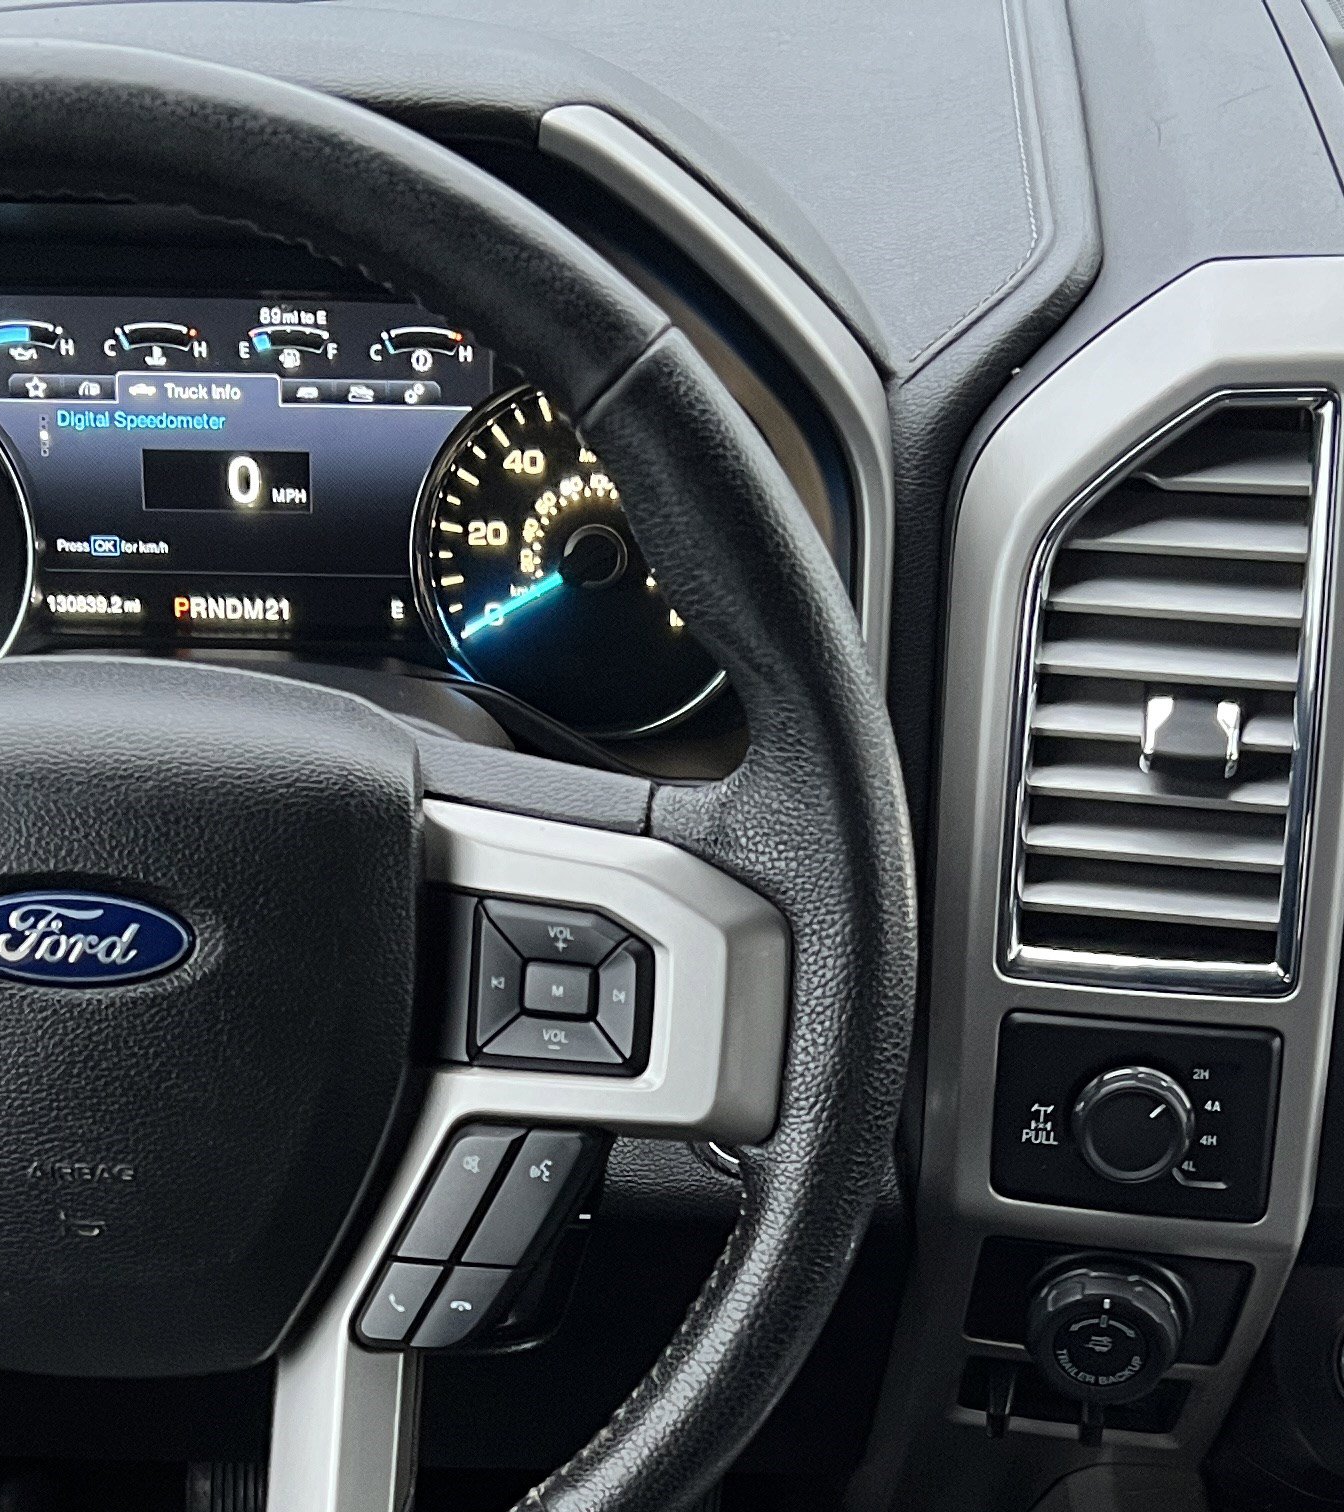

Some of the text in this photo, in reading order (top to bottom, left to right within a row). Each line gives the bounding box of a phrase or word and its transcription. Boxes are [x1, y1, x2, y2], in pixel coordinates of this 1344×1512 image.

[259, 307, 282, 325] 89
[299, 311, 315, 325] to
[316, 310, 327, 325] E
[59, 338, 75, 355] H
[103, 339, 207, 358] C H
[238, 341, 338, 359] E F
[370, 344, 473, 362] C H
[164, 382, 241, 401] Truck Info
[56, 410, 226, 431] Digital Speedometer
[503, 449, 545, 475] 40
[227, 455, 307, 504] 0 MPH
[468, 520, 508, 546] 20
[56, 538, 169, 554] Press OK for km/h
[391, 599, 404, 620] E
[547, 926, 575, 941] VOL
[551, 986, 564, 997] M
[542, 1029, 569, 1044] VOL
[1192, 1069, 1210, 1081] 2H
[1204, 1100, 1221, 1113] 4A
[1021, 1128, 1058, 1145] PULL
[1200, 1135, 1217, 1147] 4H
[1181, 1160, 1196, 1172] 4L
[1056, 1349, 1143, 1385] TRAILER BACKUP
